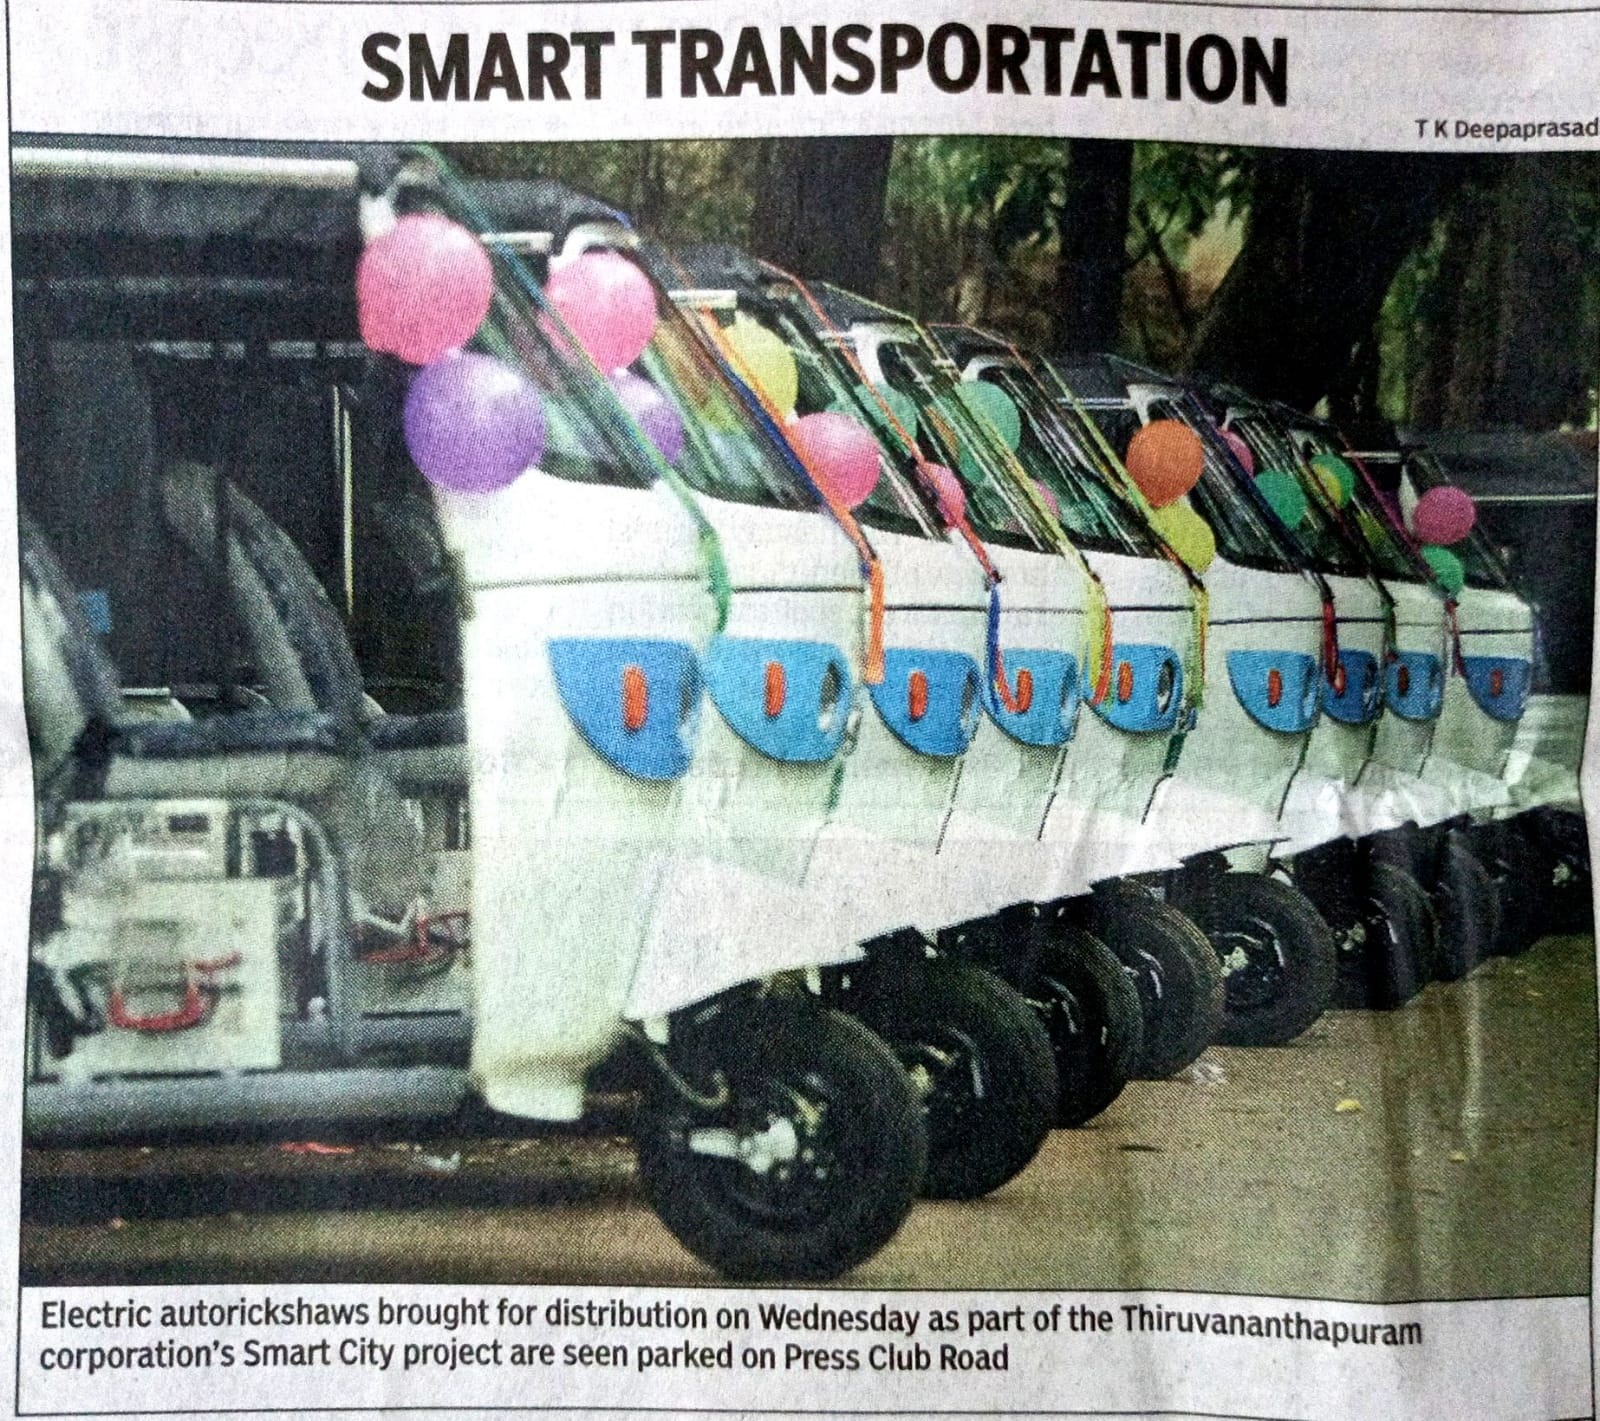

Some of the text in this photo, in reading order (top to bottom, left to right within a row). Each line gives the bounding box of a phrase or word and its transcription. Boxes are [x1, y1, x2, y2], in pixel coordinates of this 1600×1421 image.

[363, 23, 1287, 106] SMART TRANSPORTATION
[1415, 117, 1599, 142] T K Deepaprasad
[43, 1298, 1422, 1347] Electric autorickshaws brought for distribution on Wednesday as part of the Thiruvananthapuram
[244, 1340, 330, 1366] Smart
[340, 1338, 394, 1370] City
[405, 1338, 502, 1370] project
[511, 1345, 554, 1365] are
[564, 1345, 627, 1366] seen
[638, 1341, 732, 1372] parked
[742, 1348, 775, 1368] on
[786, 1344, 859, 1370] Press
[869, 1343, 930, 1370] Club
[941, 1343, 1008, 1370] Road
